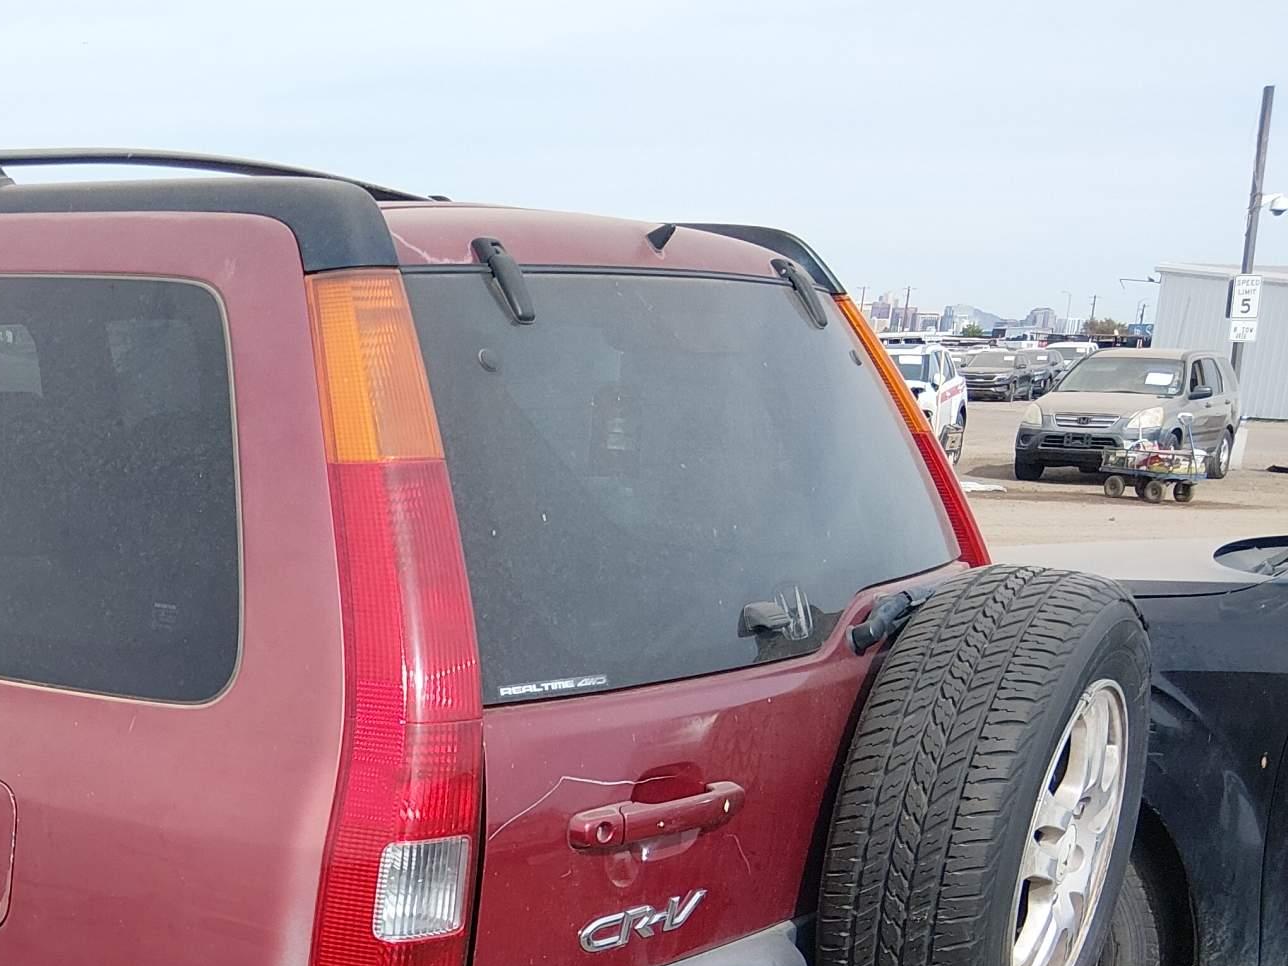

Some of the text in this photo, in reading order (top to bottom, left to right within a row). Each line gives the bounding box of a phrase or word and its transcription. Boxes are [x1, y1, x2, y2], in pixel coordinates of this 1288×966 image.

[1237, 279, 1261, 287] SPEED
[1238, 288, 1257, 296] LIMIT
[1240, 298, 1251, 314] 5
